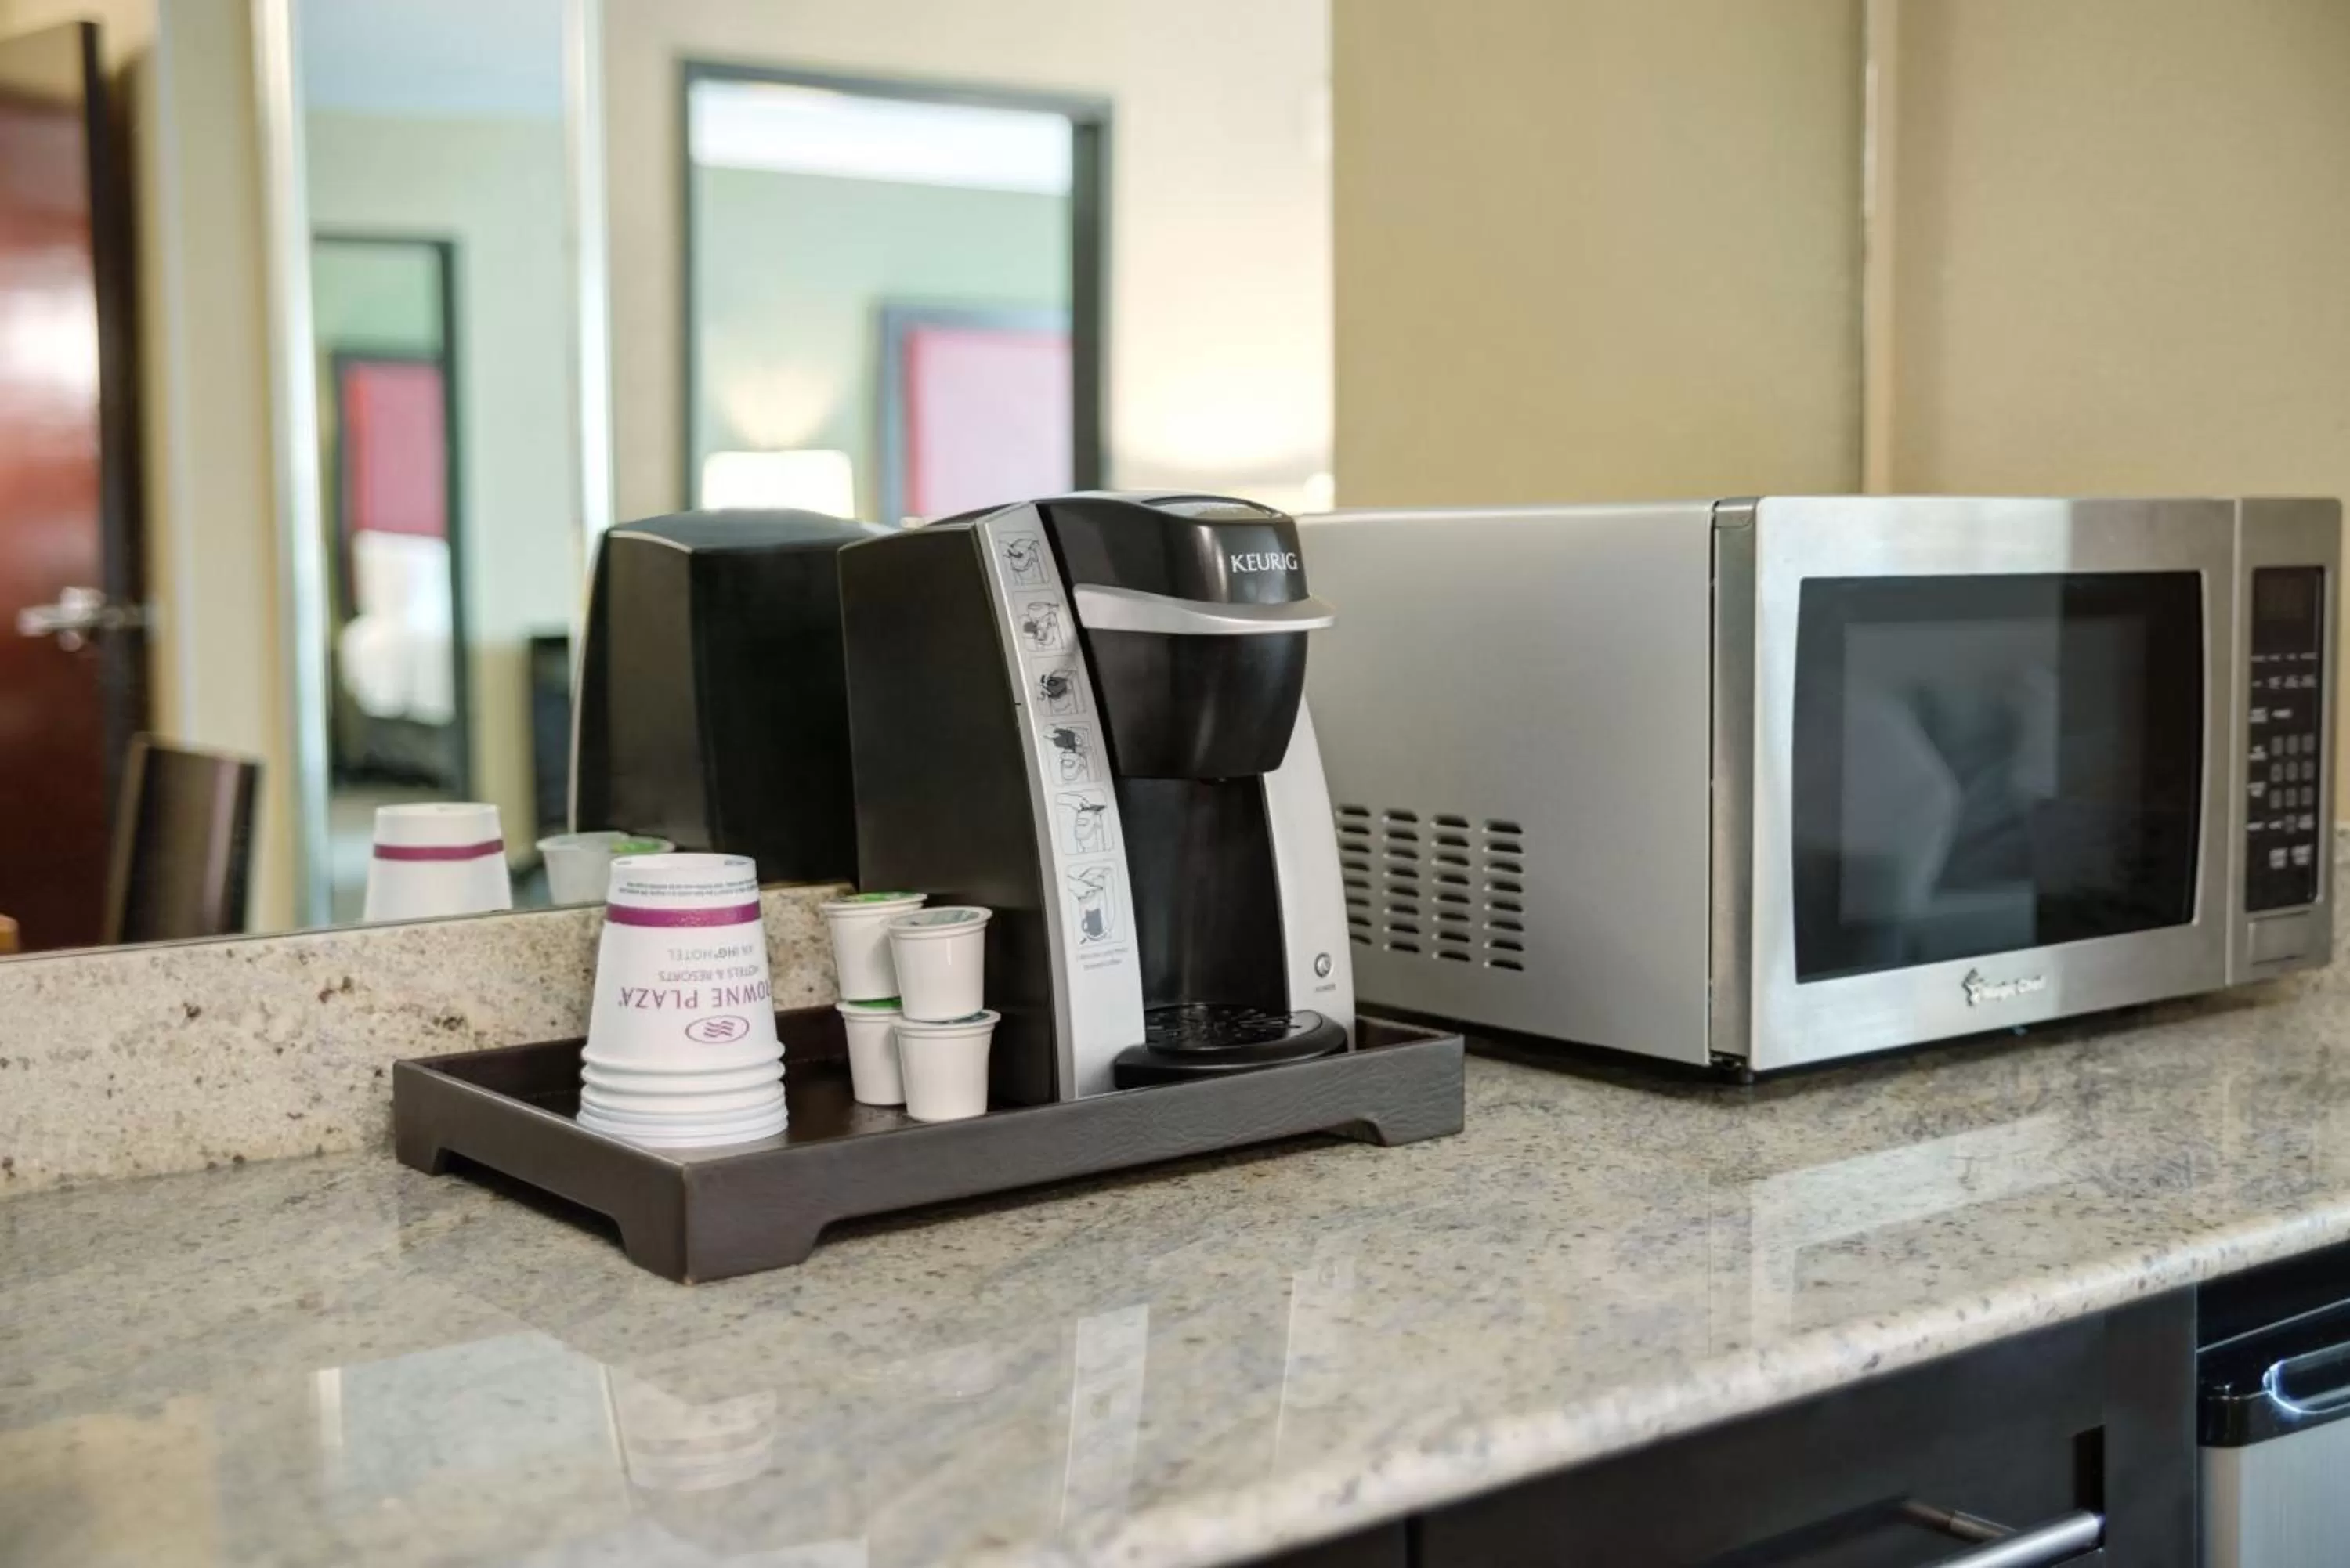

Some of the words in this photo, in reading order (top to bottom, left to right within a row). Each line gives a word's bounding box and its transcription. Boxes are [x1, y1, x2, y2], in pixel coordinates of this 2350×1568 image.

[1231, 551, 1298, 573] KEURIG
[667, 948, 713, 960] HOTEL
[658, 970, 712, 981] RESORTS
[620, 987, 698, 1009] PLAZA
